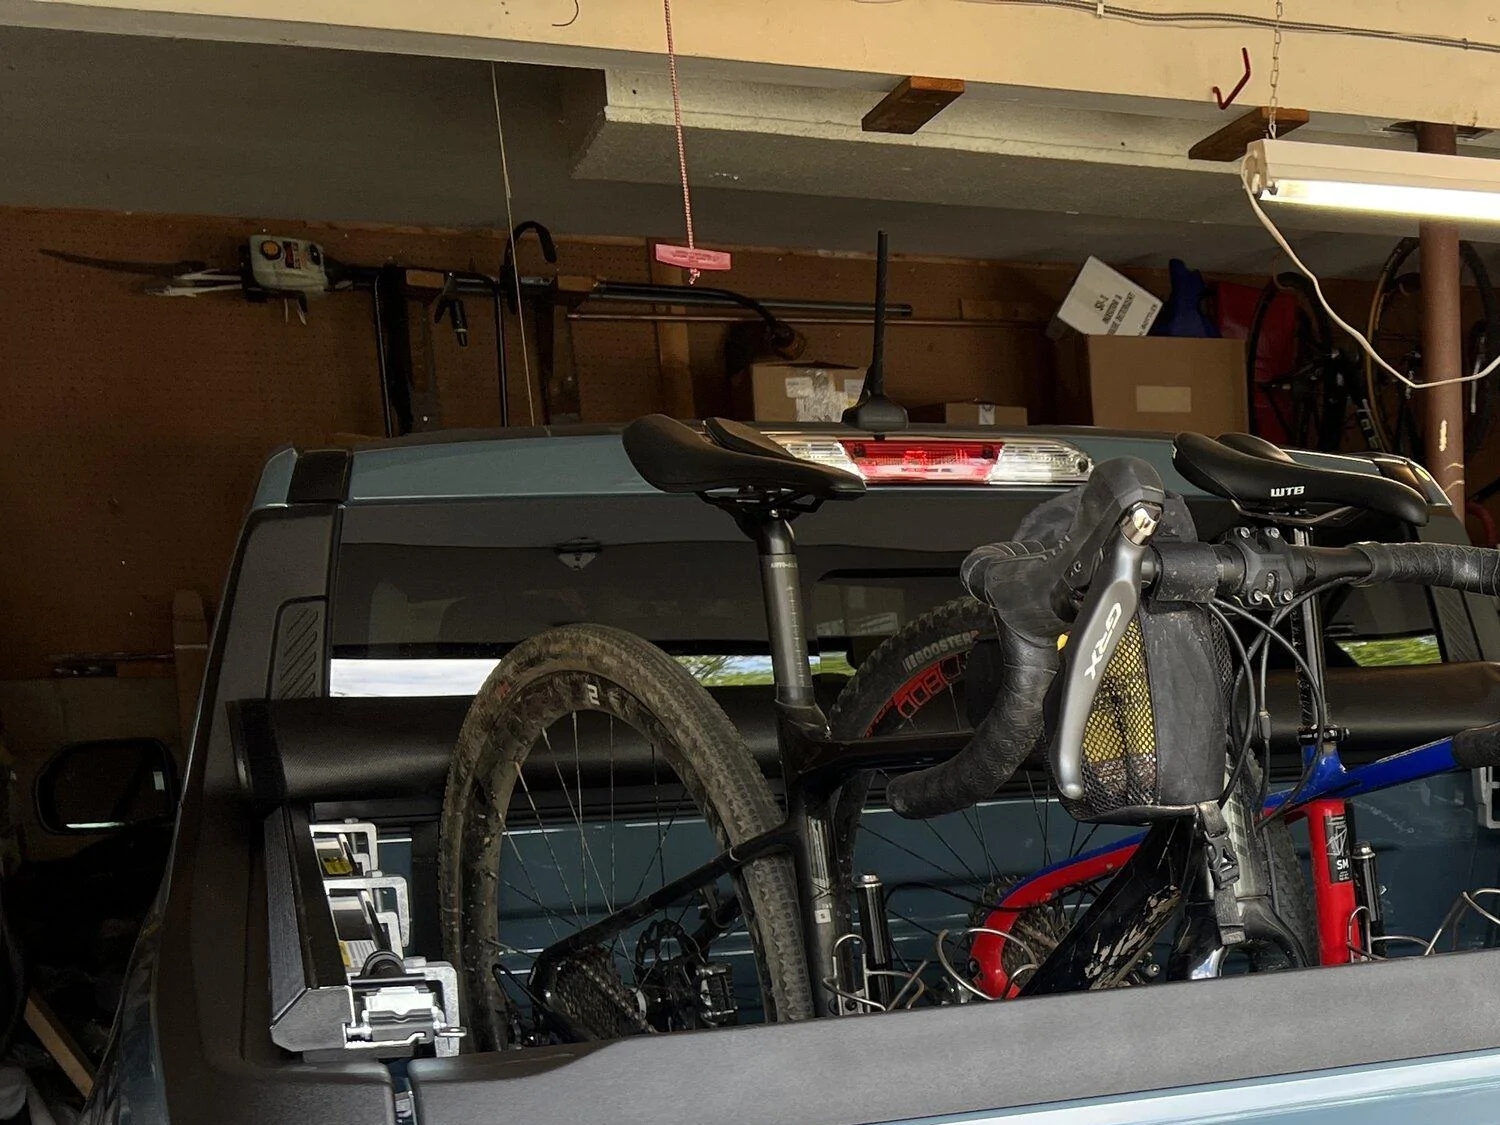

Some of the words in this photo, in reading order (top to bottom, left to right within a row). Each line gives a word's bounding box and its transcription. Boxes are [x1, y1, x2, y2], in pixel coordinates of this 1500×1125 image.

[1270, 485, 1305, 498] WTB
[1084, 602, 1122, 680] GRX
[1336, 858, 1349, 871] SM
